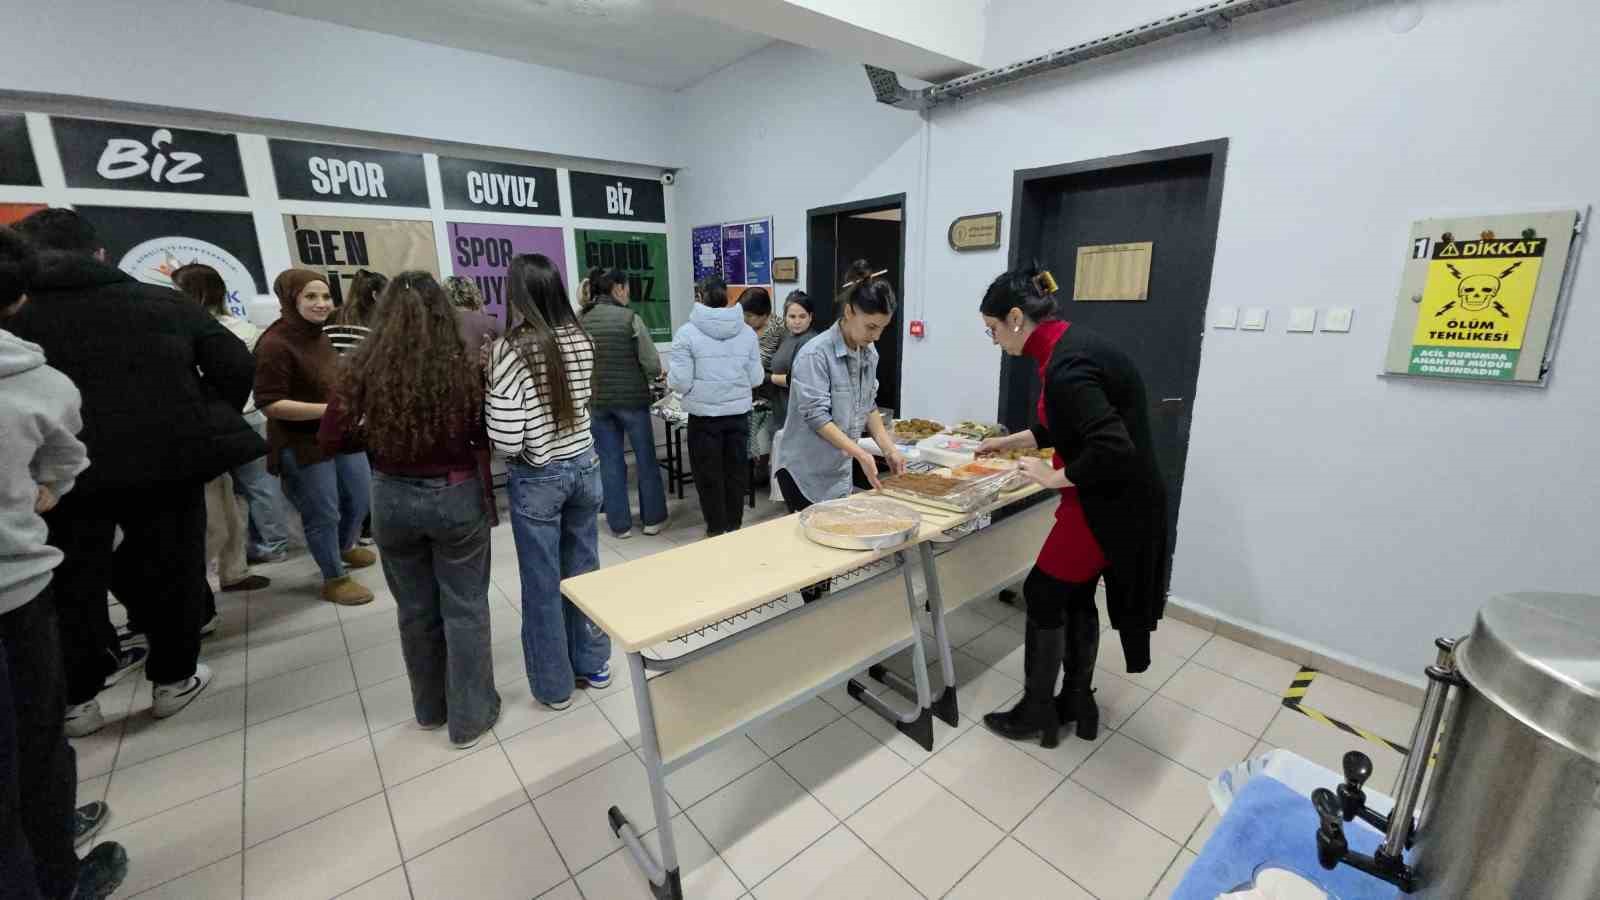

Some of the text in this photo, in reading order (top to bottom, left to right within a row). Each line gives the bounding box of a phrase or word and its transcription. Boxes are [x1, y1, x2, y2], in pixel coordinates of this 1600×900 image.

[96, 128, 205, 184] Biz
[308, 156, 388, 198] SPOR
[467, 170, 538, 208] CUYUZ
[606, 182, 634, 216] BİZ
[295, 229, 369, 266] GEN
[455, 236, 513, 268] SPOR
[1414, 238, 1428, 259] 1
[1462, 239, 1541, 256] DİKKAT
[1428, 329, 1509, 342] TEHLİKESİ
[1446, 318, 1495, 330] ÖLÜM
[1419, 349, 1508, 361] ACİL DURUMDA
